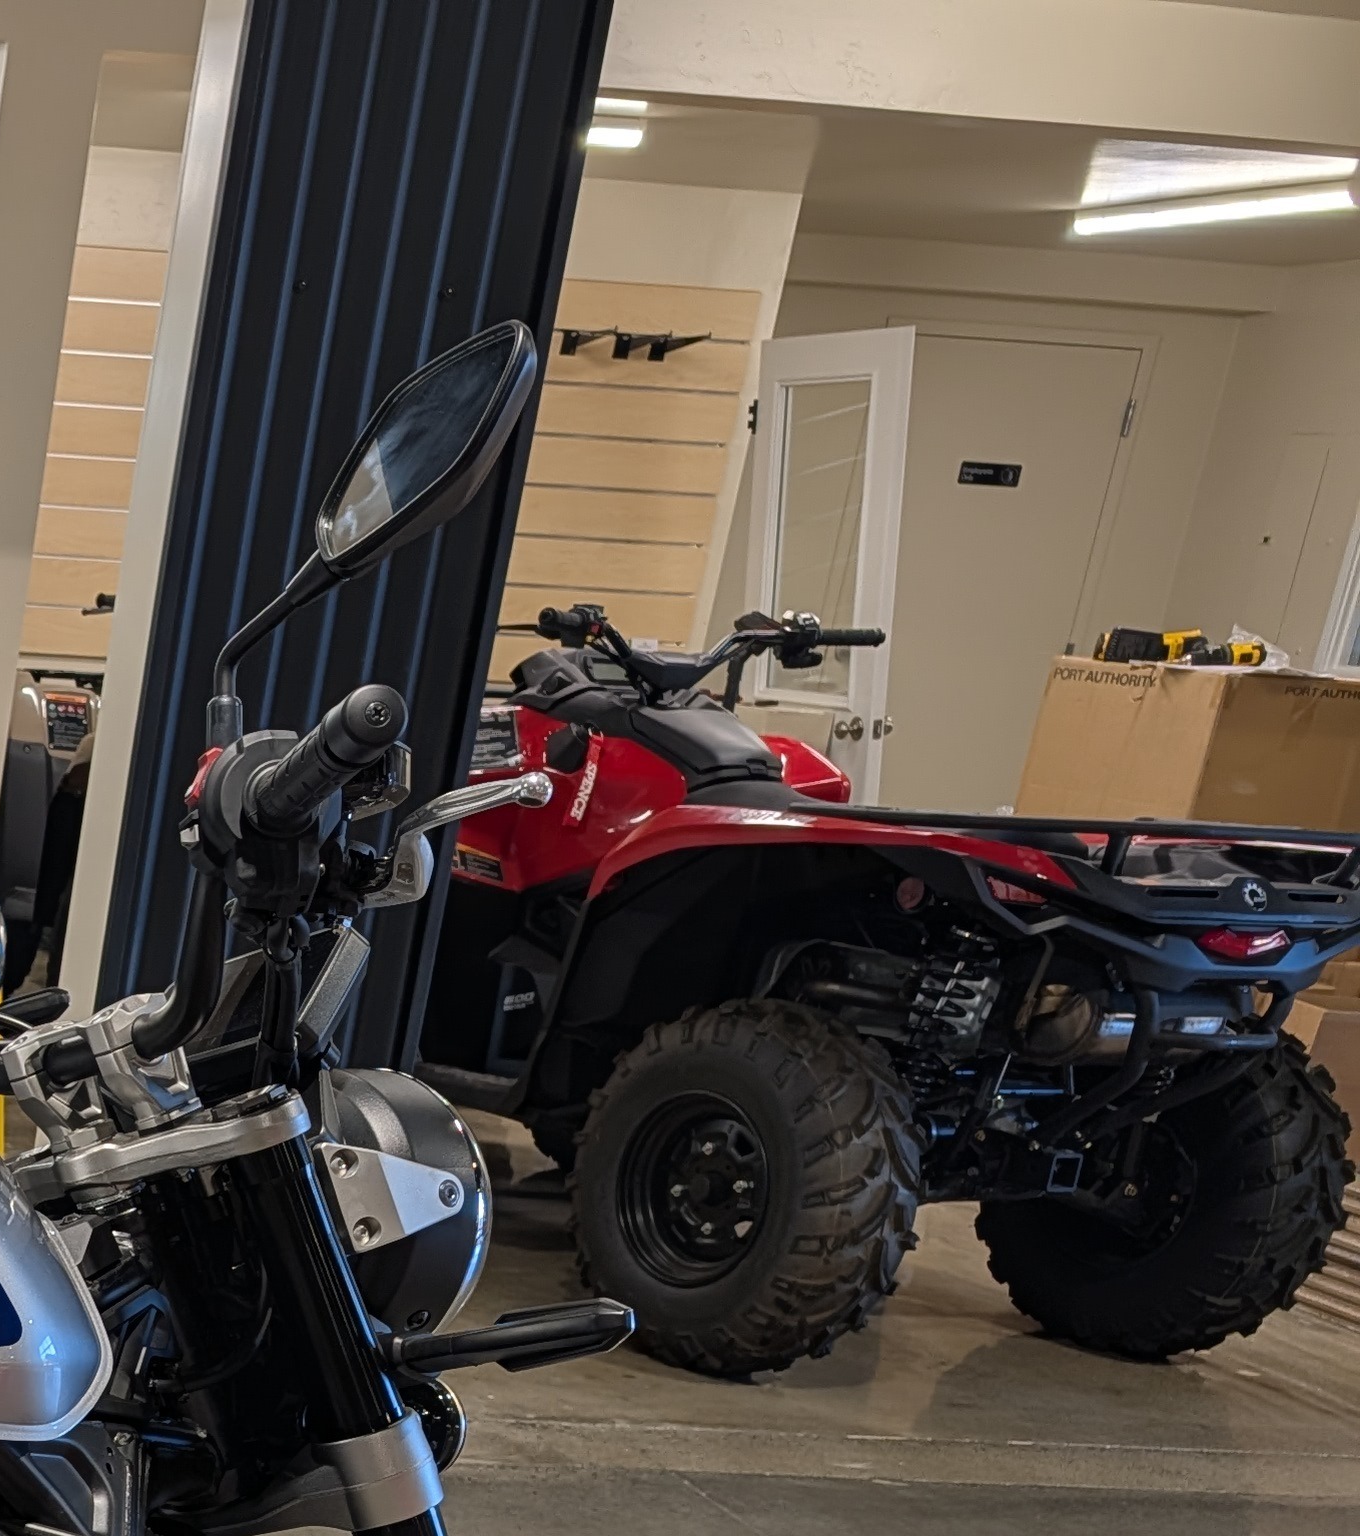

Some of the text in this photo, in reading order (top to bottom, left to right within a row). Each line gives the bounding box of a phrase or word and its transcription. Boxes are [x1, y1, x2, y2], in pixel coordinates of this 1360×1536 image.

[1053, 667, 1158, 688] PORT AUTHORITY
[1284, 685, 1320, 698] PORT
[569, 761, 598, 822] SPENCE
